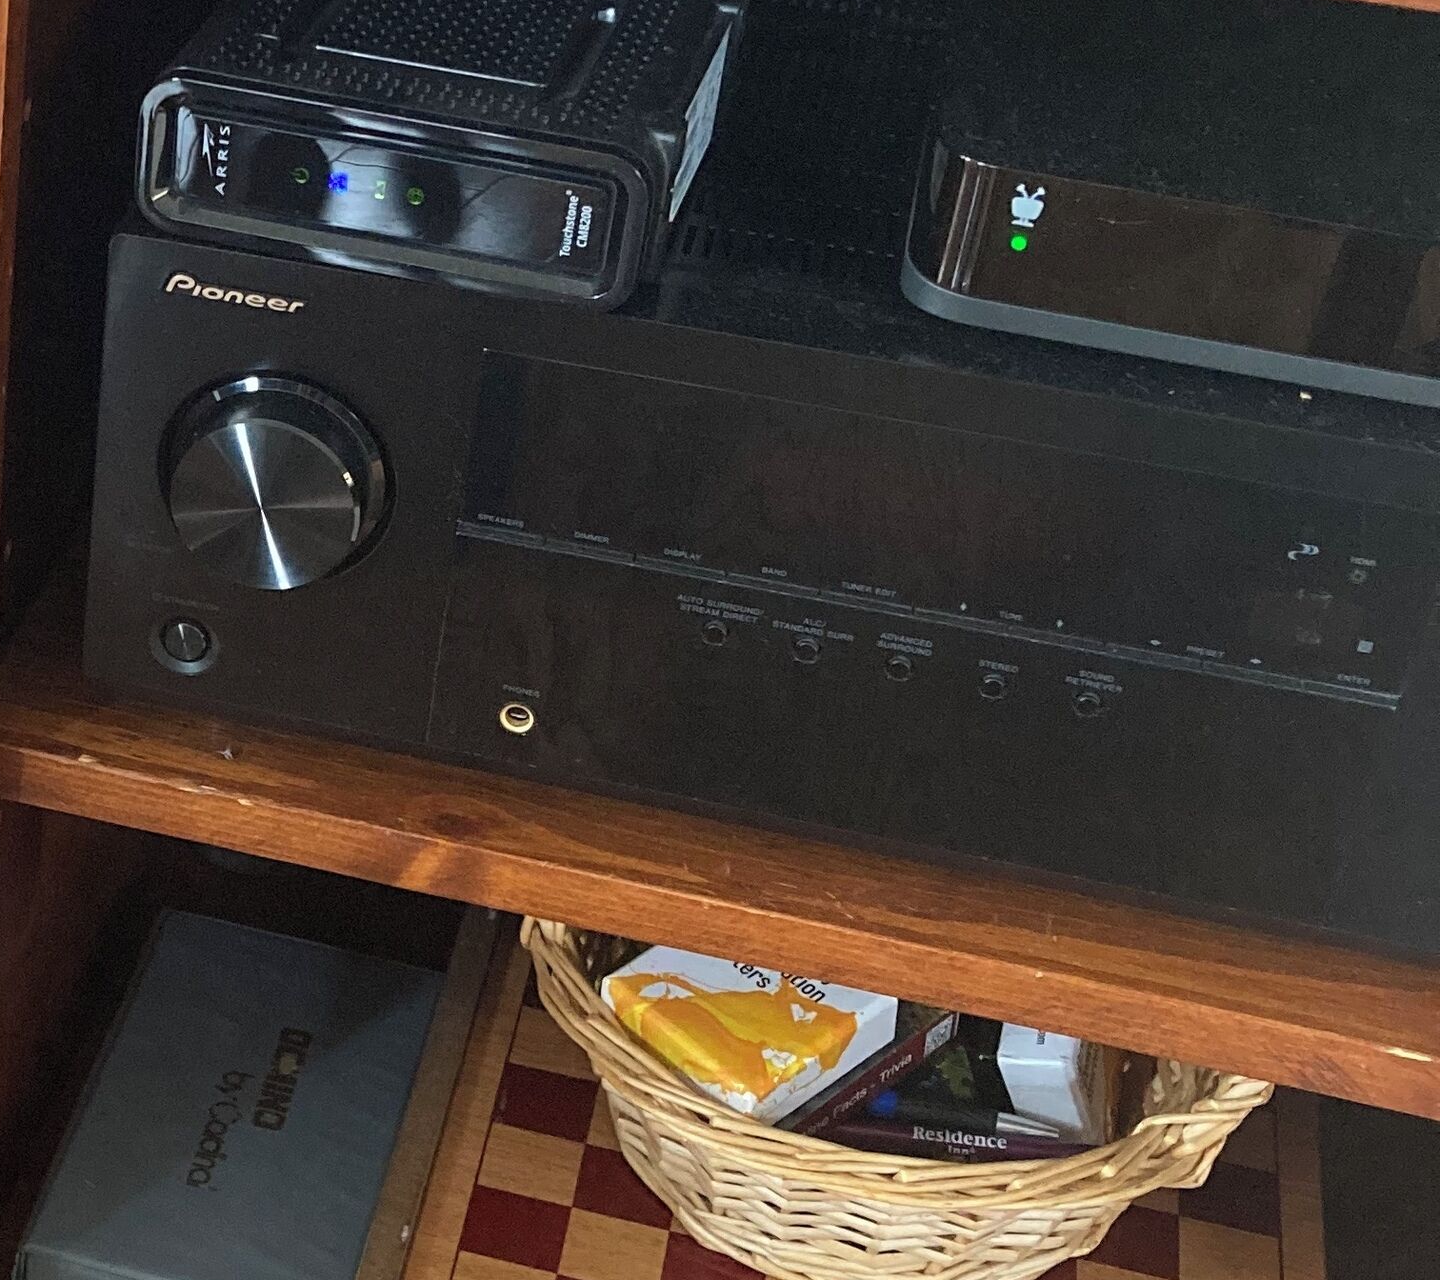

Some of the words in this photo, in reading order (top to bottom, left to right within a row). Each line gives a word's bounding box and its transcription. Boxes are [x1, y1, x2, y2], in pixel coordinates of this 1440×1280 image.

[215, 125, 231, 196] ARRIS
[559, 195, 579, 257] Touchstone
[576, 205, 593, 248] CM8200
[165, 273, 304, 315] Pioneer
[762, 566, 787, 577] BAND
[216, 1071, 255, 1093] by
[879, 1054, 913, 1082] Trivia
[913, 1126, 1008, 1150] Residence
